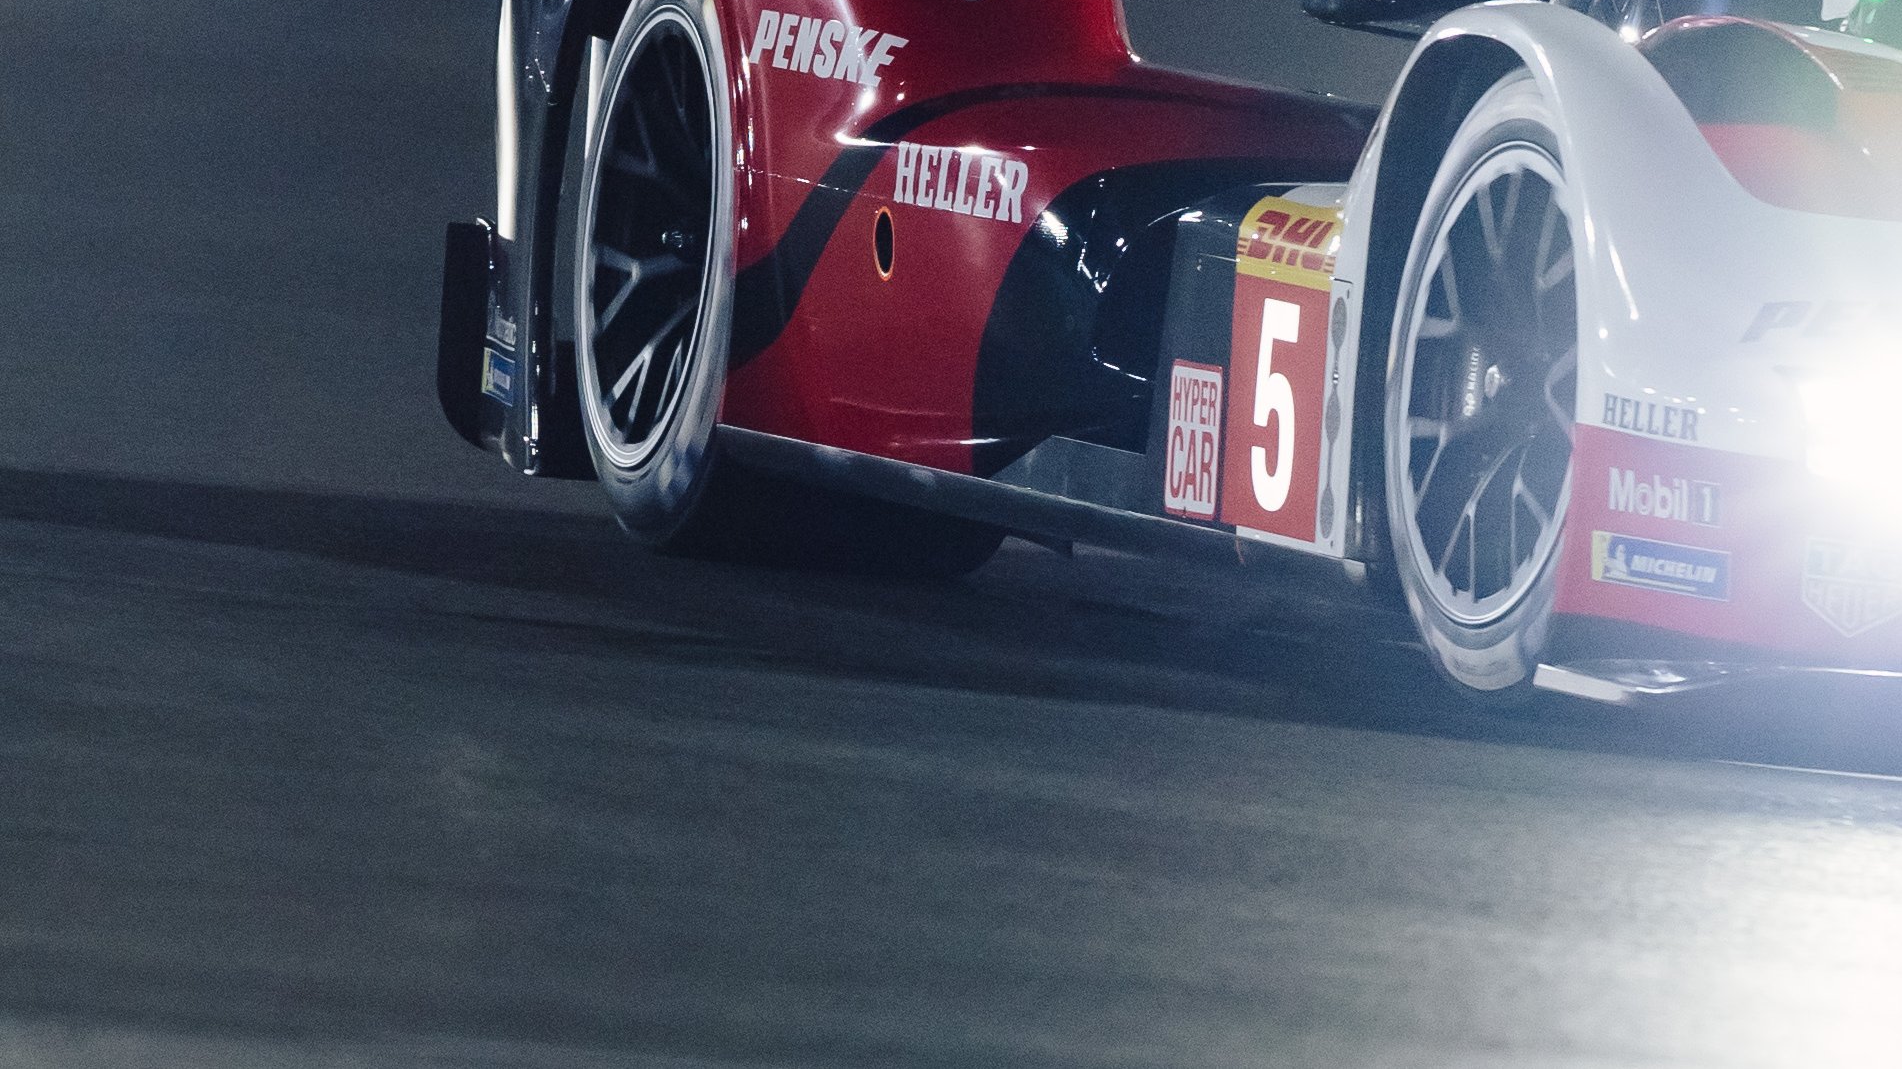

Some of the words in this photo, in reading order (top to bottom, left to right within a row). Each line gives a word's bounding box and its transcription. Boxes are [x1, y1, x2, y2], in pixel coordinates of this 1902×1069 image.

[748, 10, 910, 88] PENSKE
[893, 141, 1030, 224] HELLER
[1245, 209, 1334, 271] DHL
[1172, 374, 1220, 426] HYPER
[1249, 296, 1301, 512] 5
[1602, 391, 1699, 442] HELLER
[1168, 427, 1215, 505] CAR
[1608, 465, 1689, 523] Mobil
[1630, 554, 1718, 584] MICHELIN
